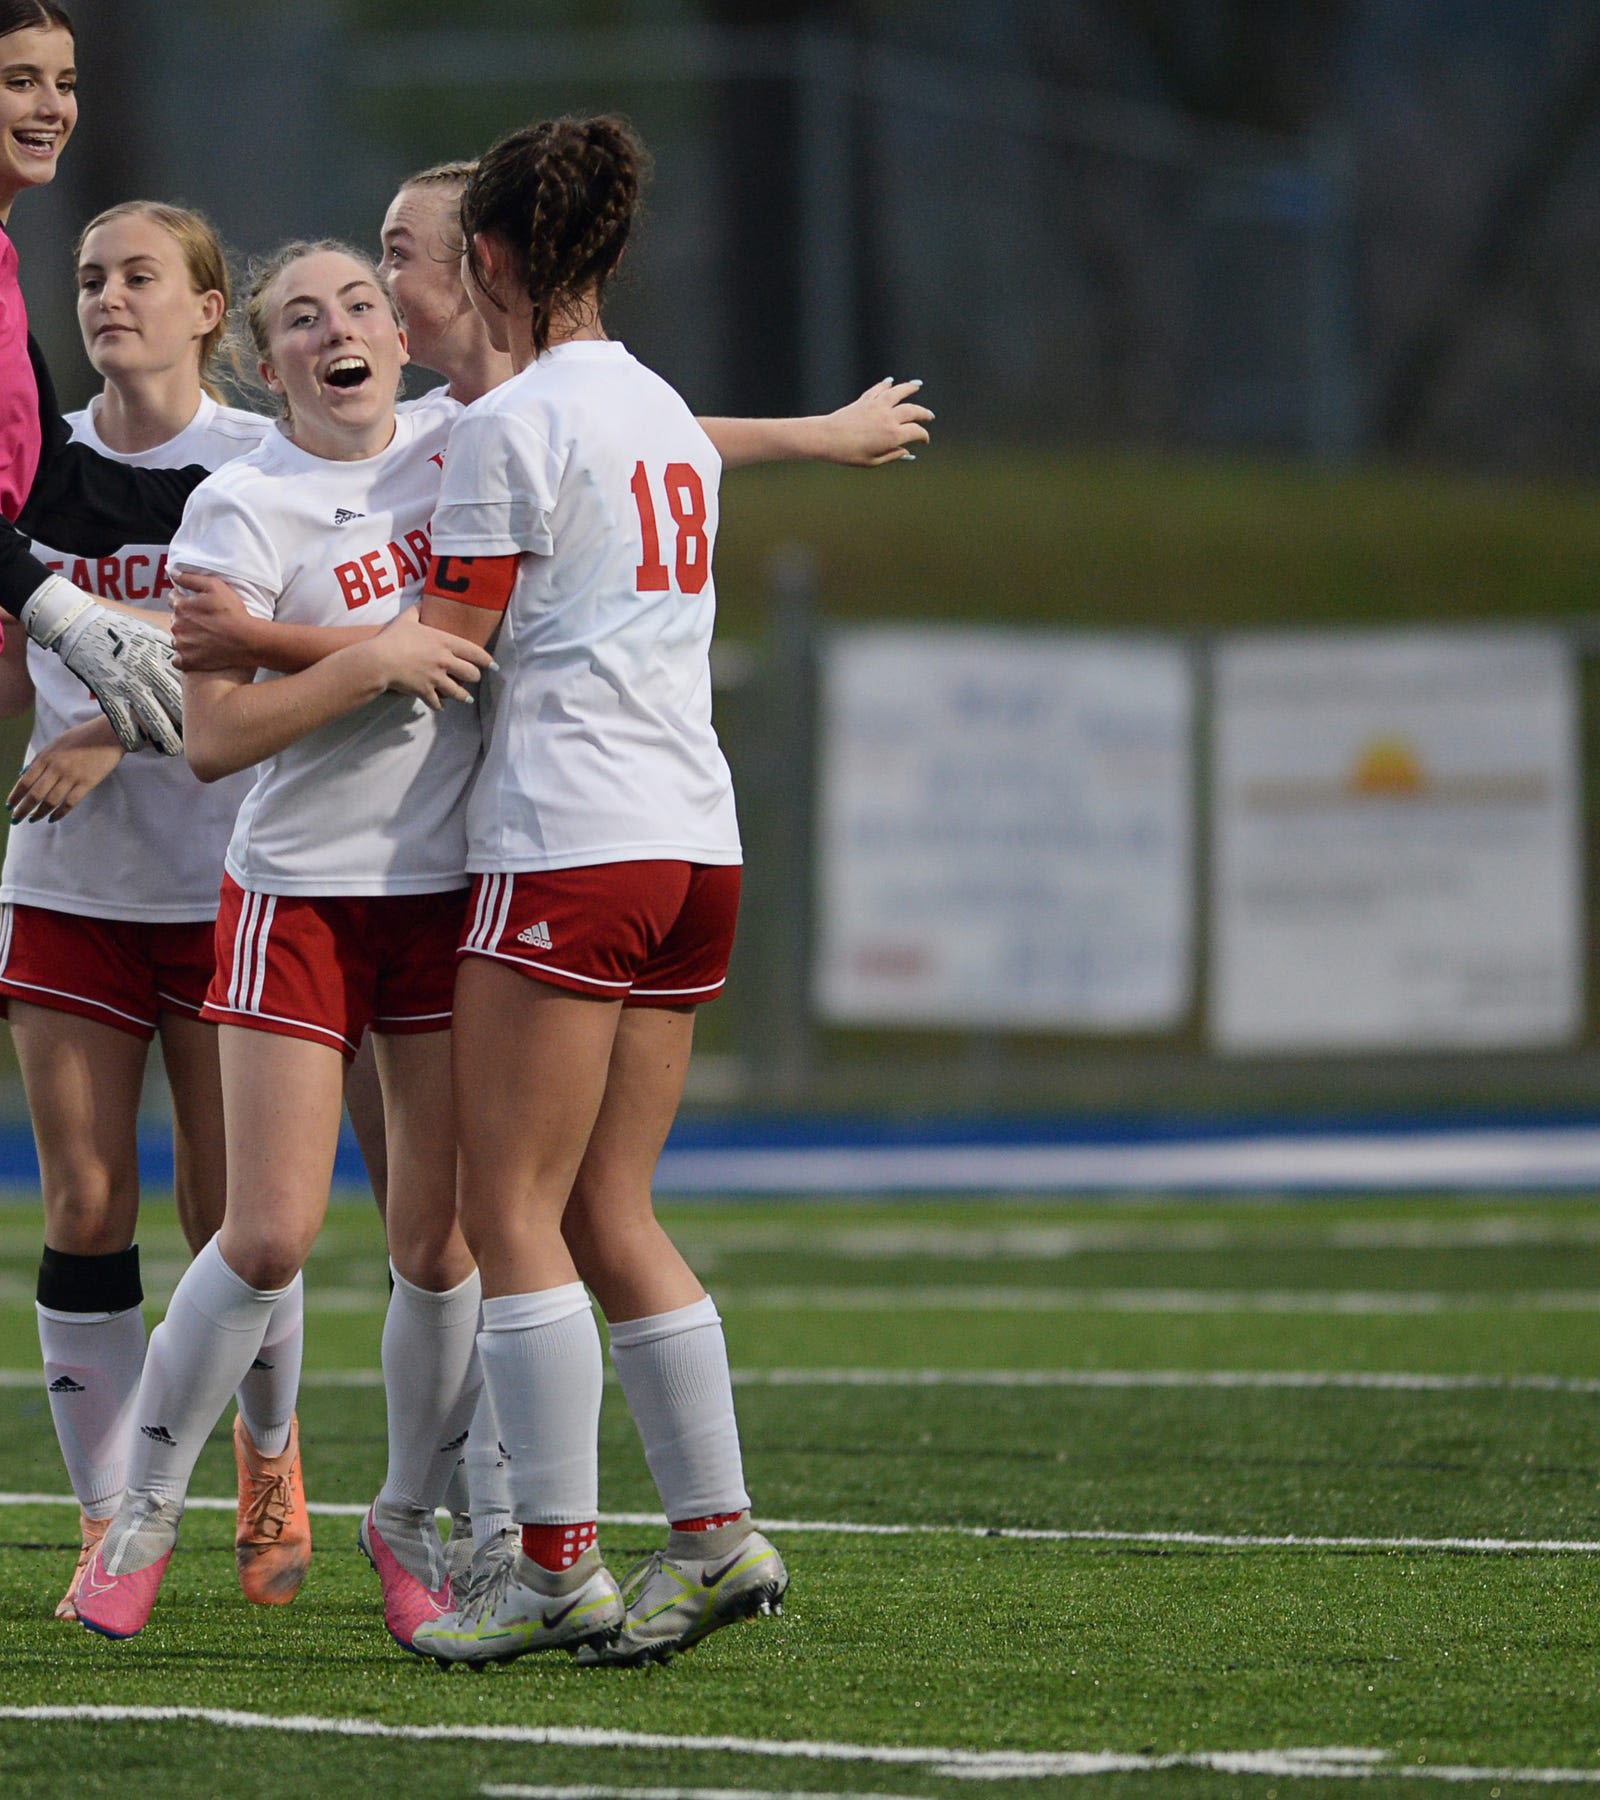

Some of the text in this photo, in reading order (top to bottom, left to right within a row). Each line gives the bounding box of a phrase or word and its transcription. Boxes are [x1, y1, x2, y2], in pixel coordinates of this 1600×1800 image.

[631, 461, 708, 594] 18
[334, 521, 432, 610] BEAR
[435, 556, 472, 593] C
[517, 932, 553, 950] adidas
